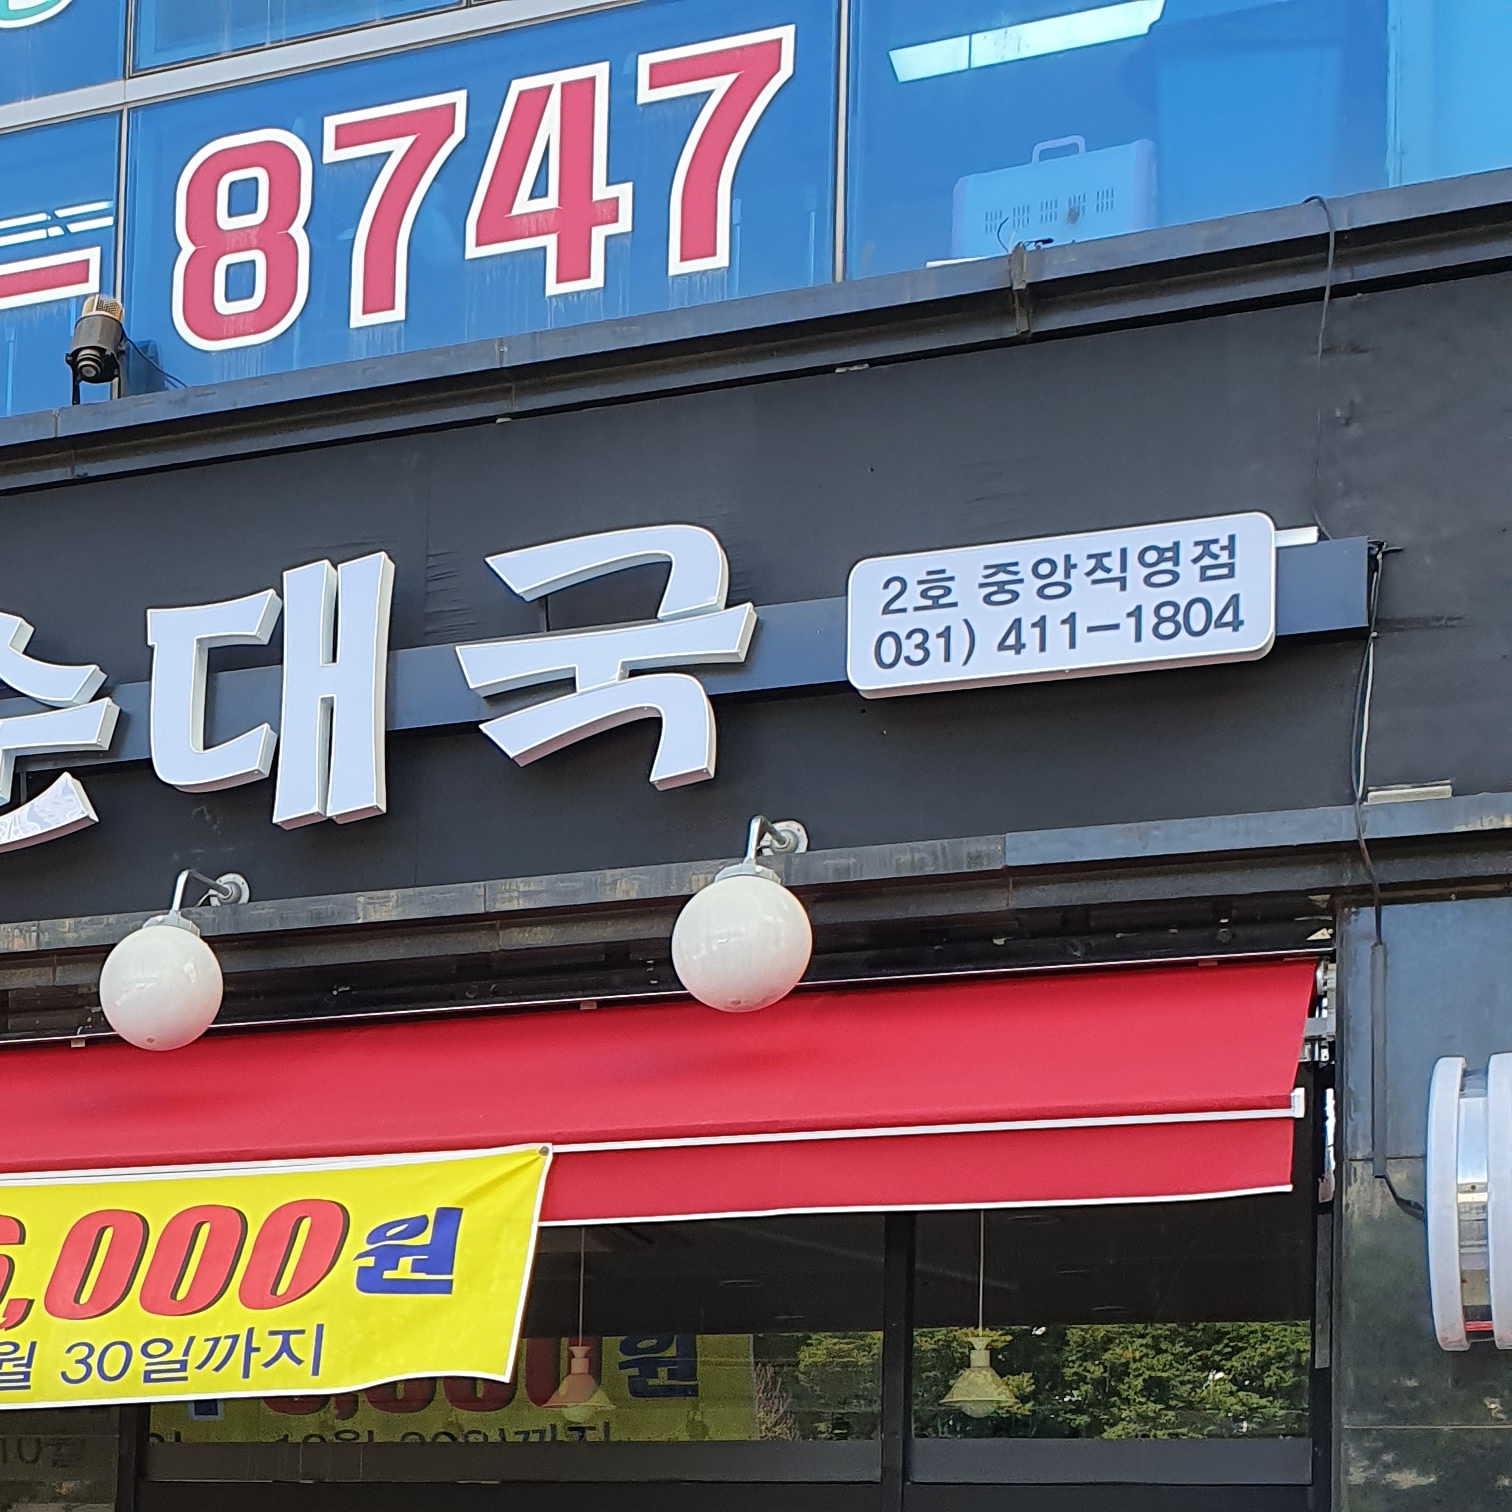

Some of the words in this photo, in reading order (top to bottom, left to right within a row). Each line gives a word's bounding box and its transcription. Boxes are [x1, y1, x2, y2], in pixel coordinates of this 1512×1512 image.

[880, 566, 960, 618] 2호
[977, 532, 1239, 607] 중앙직영점
[873, 617, 976, 672] 031)
[996, 593, 1245, 657] 411-1804
[59, 1322, 324, 1386] 30일까지
